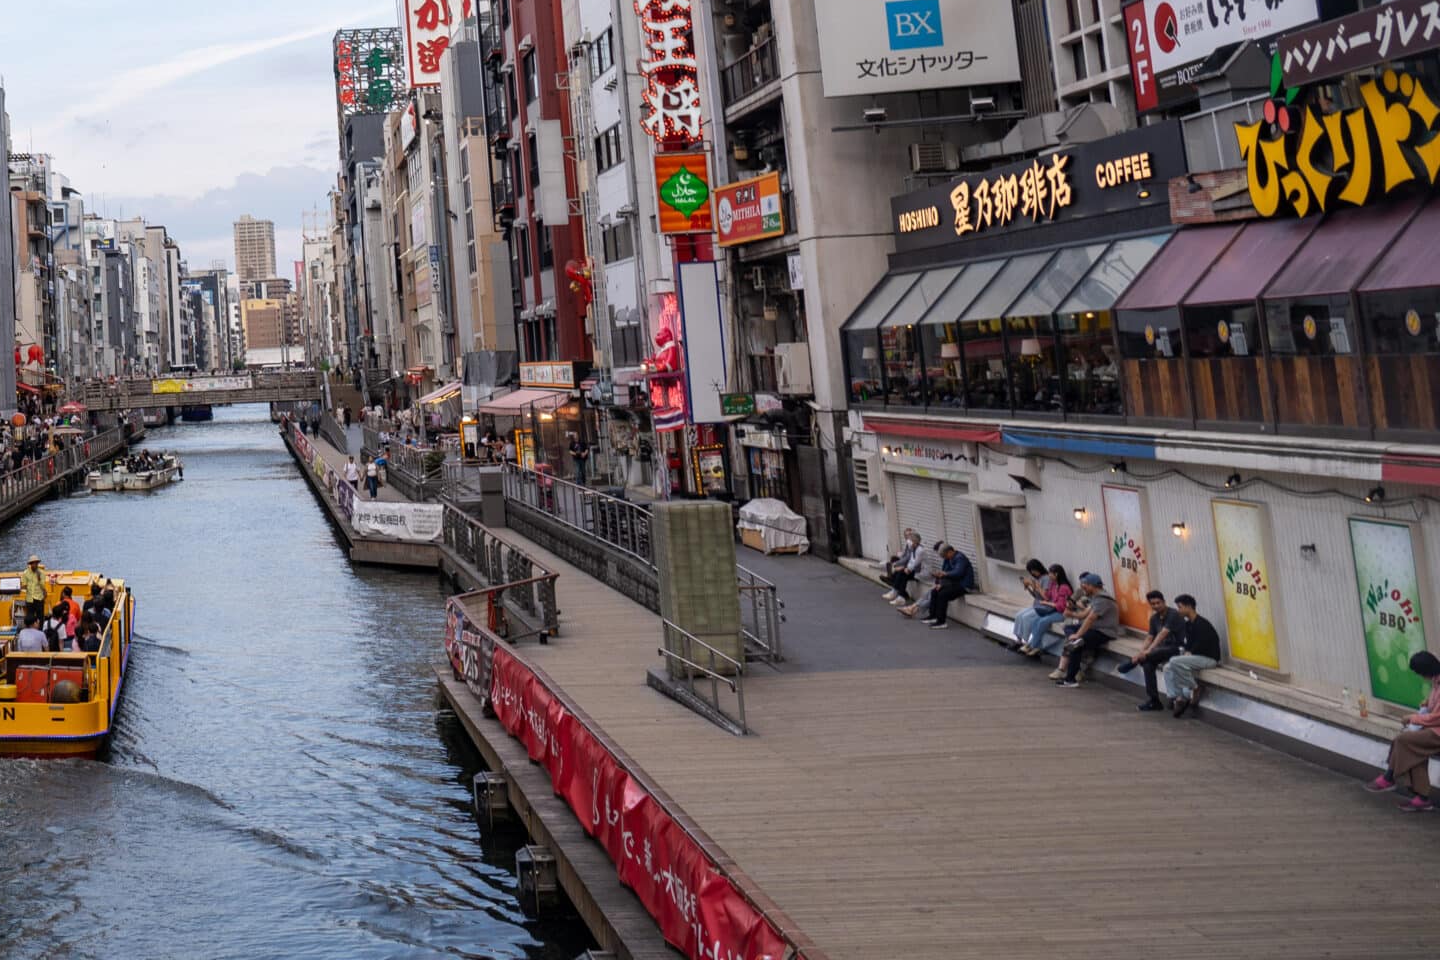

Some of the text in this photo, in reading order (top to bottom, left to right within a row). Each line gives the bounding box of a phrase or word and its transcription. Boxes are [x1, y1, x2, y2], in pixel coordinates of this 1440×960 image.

[1179, 1, 1205, 21] お好み焼
[893, 10, 936, 38] BX
[1131, 17, 1151, 97] 2F
[1095, 151, 1152, 189] COFFEE
[671, 184, 698, 198] حلال
[898, 154, 1073, 236] HOSHINO 星乃珈琲店
[689, 214, 712, 229] 2F
[732, 205, 761, 221] MITHILA
[1121, 557, 1138, 573] BBQ
[1236, 581, 1257, 600] BBQ
[1377, 610, 1407, 634] BBQ
